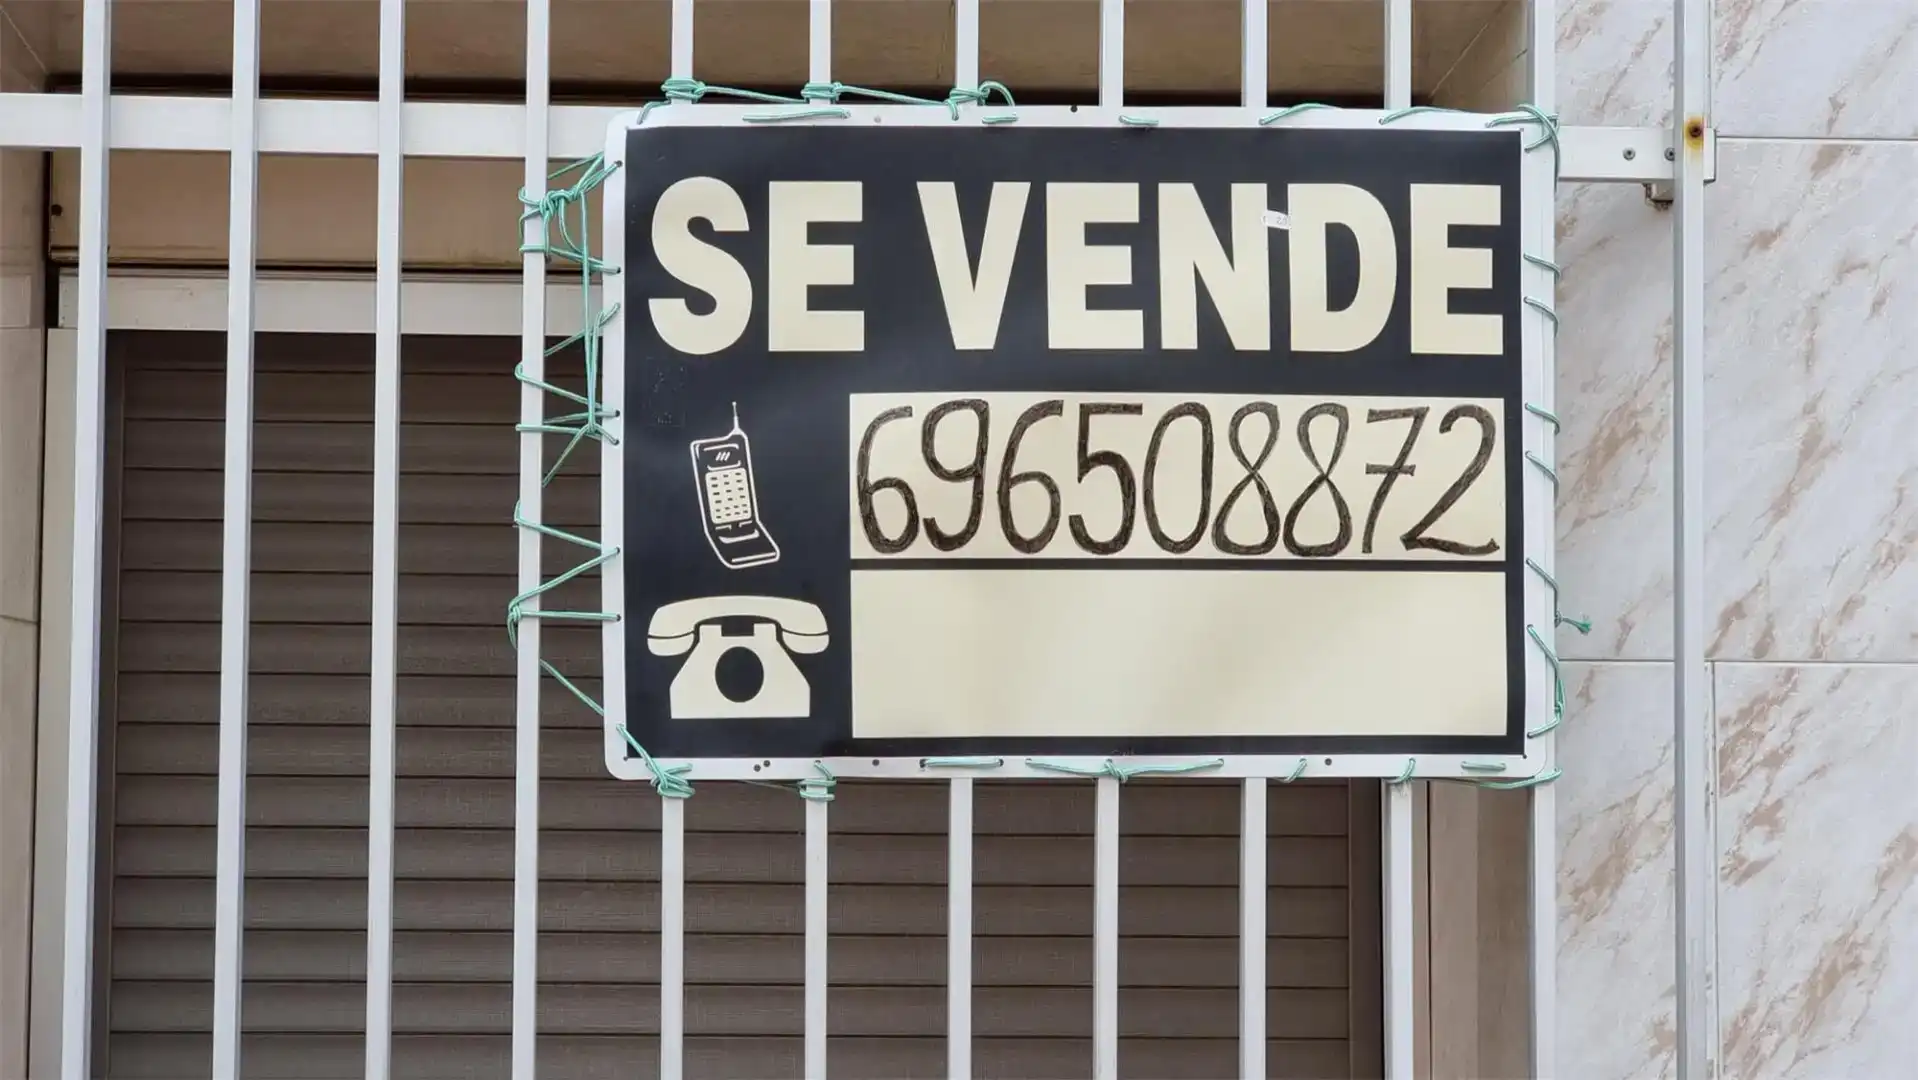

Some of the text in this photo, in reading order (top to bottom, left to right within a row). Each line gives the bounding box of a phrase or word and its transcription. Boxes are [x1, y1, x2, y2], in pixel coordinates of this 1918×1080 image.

[648, 176, 1504, 356] SE VENDE
[856, 398, 1500, 557] 696508872
